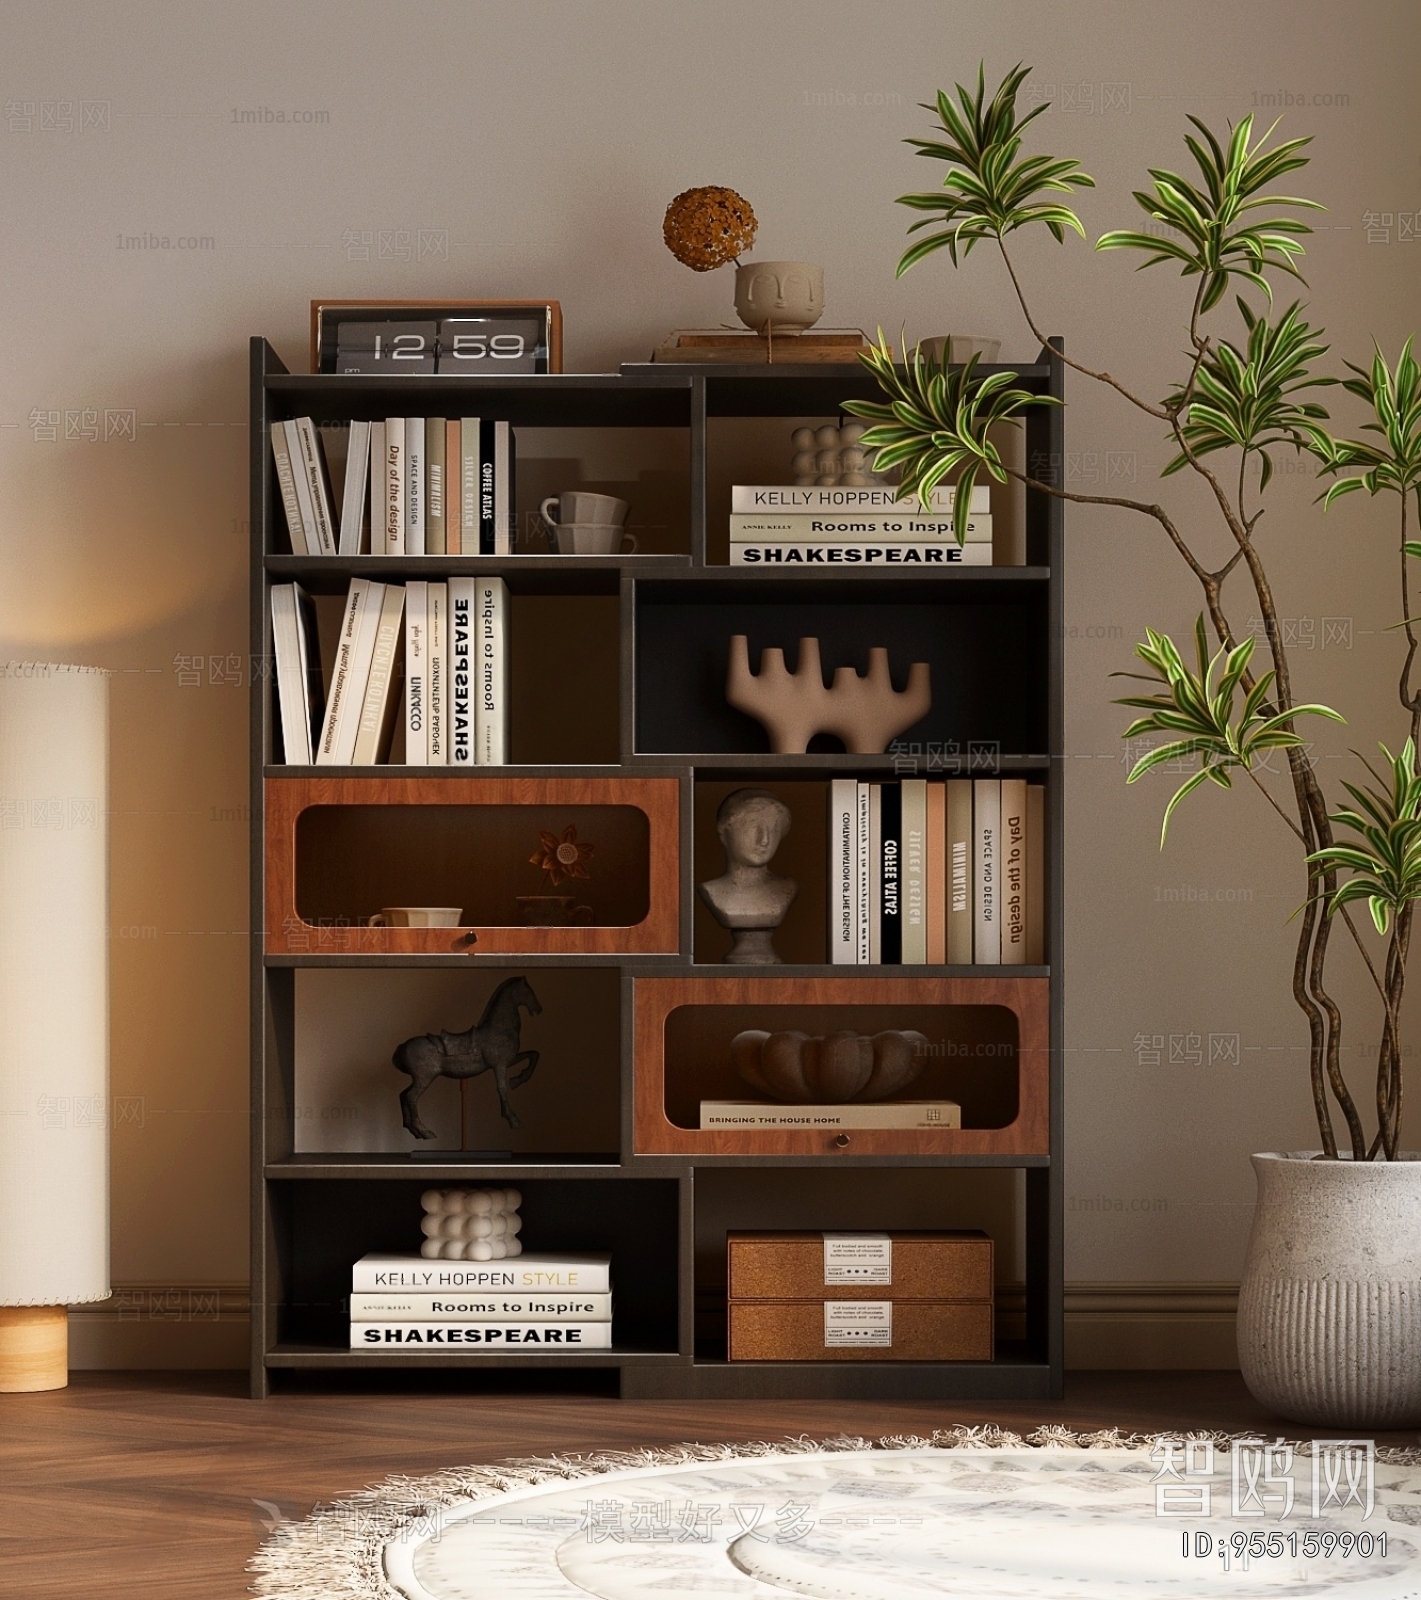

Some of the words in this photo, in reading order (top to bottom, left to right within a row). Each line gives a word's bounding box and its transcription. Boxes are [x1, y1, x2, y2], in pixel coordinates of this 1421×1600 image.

[389, 445, 399, 466] Day
[389, 469, 400, 481] of
[482, 463, 492, 492] COFFEE
[389, 483, 399, 500] the
[431, 464, 441, 517] MINIMALISM
[755, 492, 812, 504] KELLY
[820, 492, 895, 504] HOPPEN
[482, 494, 492, 520] ATLAS
[388, 504, 400, 541] design
[811, 521, 876, 532] Rooms
[884, 521, 902, 532] to
[909, 521, 975, 535] Inspie
[743, 548, 963, 563] SHAKESPEARE
[376, 1273, 432, 1285] KELLY
[440, 1273, 515, 1285] HOPPEN
[522, 1273, 579, 1285] STYLE
[432, 1302, 496, 1312] Rooms
[502, 1302, 521, 1312] to
[529, 1301, 594, 1314] Inspire
[363, 1329, 582, 1343] SHAKESPEARE
